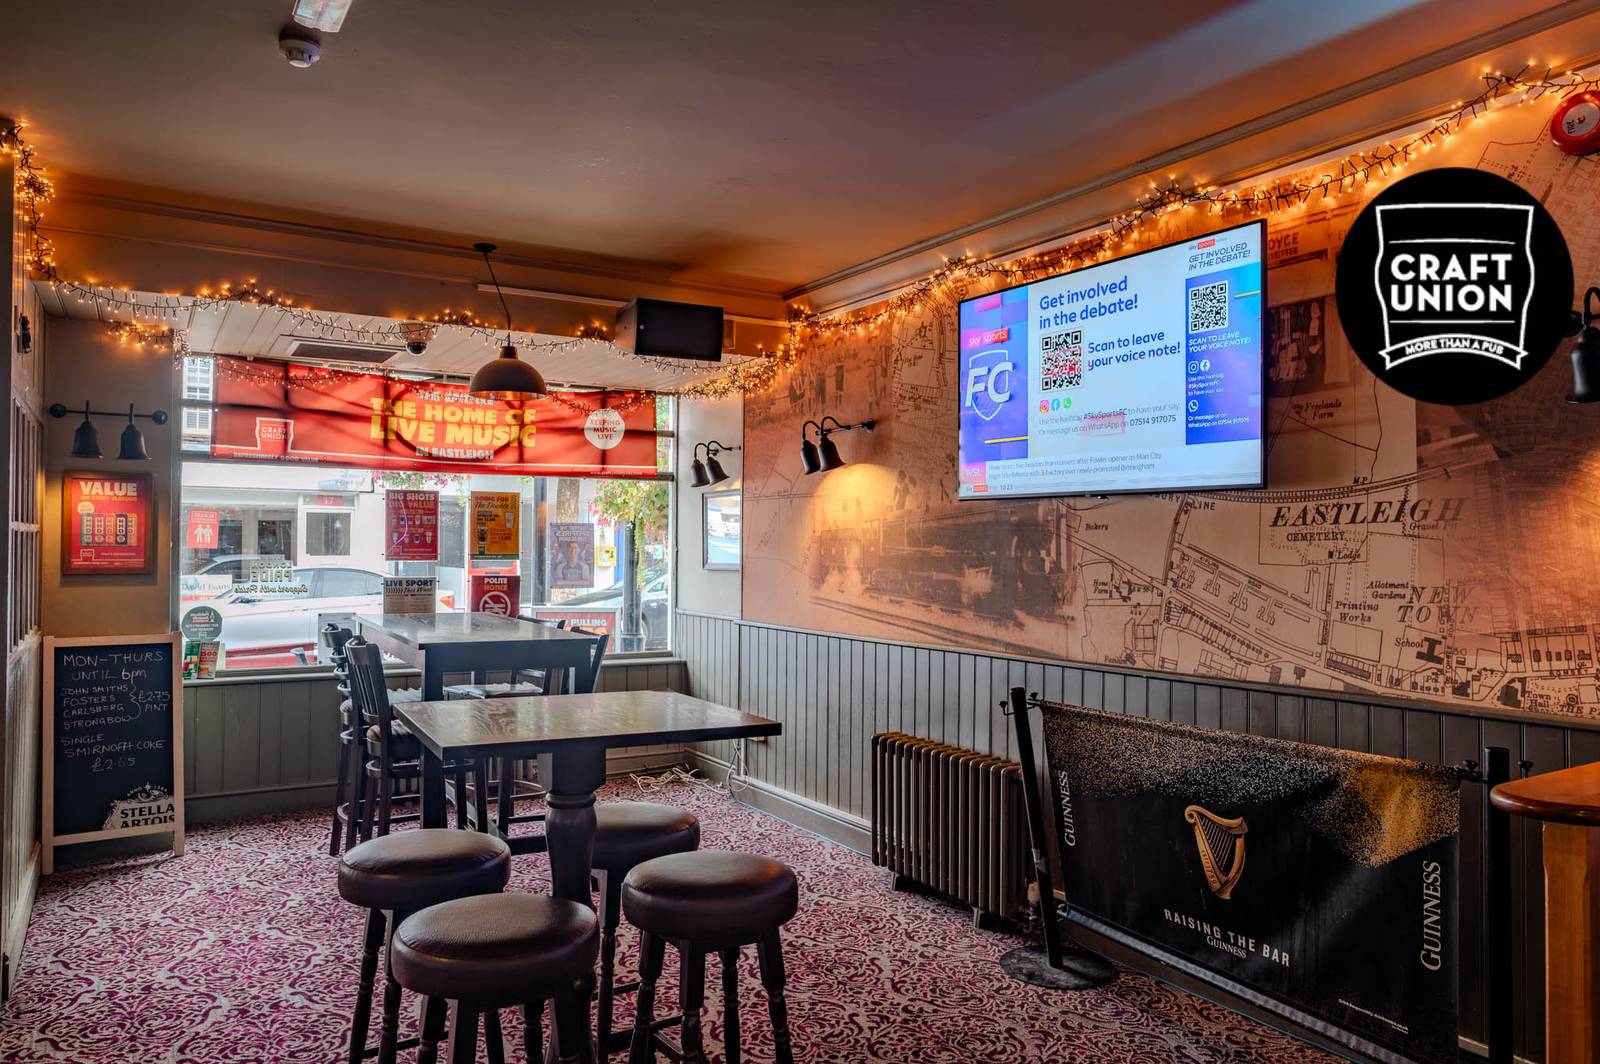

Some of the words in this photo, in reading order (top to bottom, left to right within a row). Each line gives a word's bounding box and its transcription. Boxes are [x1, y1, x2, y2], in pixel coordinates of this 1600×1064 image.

[1189, 252, 1205, 263] GET
[1206, 242, 1248, 258] INVOLVED
[1189, 263, 1198, 271] IN
[1198, 258, 1214, 268] THE
[1216, 249, 1251, 264] DEBATE!
[1040, 293, 1064, 311] Get
[1067, 275, 1128, 305] involved
[1040, 315, 1051, 329] in
[1054, 311, 1077, 326] the
[1080, 293, 1139, 320] debate!
[969, 336, 982, 347] sky
[983, 329, 1008, 343] sports
[1088, 341, 1115, 354] Scan
[1117, 338, 1130, 348] to
[1132, 332, 1165, 345] leave
[1189, 337, 1207, 346] SCAN
[1218, 331, 1240, 341] LEAVE
[1189, 344, 1207, 352] YOUR
[1208, 341, 1229, 350] VOICE
[1088, 356, 1113, 371] your
[1115, 350, 1146, 364] voice
[1148, 342, 1181, 359] note!
[965, 362, 1013, 408] FC
[370, 397, 417, 418] THE
[424, 404, 497, 425] HOME
[505, 408, 536, 424] OF
[1084, 407, 1128, 420] #SkySportsFC
[1130, 417, 1150, 426] 07514
[1151, 414, 1176, 425] 917075
[261, 426, 287, 434] CRAFT
[370, 415, 435, 442] LIVE
[445, 423, 537, 448] MUSIC
[416, 447, 429, 457] IN
[431, 448, 494, 460] EASTLEIGH
[80, 481, 138, 497] VALUE
[323, 496, 335, 505] 17
[389, 492, 404, 501] BIG
[406, 492, 436, 501] SHOTS
[1269, 497, 1466, 528] EASTLEIGH
[1286, 532, 1346, 542] CEMETERY
[1337, 551, 1361, 561] Lodge
[405, 579, 433, 587] SPORT
[1367, 580, 1409, 590] Allotment
[1371, 590, 1406, 600] Gardens
[1408, 585, 1476, 605] NEW
[1335, 600, 1379, 612] Printing
[1340, 612, 1372, 623] Works
[1397, 604, 1481, 624] TOWN
[571, 618, 607, 627] PULLING
[1395, 637, 1424, 649] School
[71, 670, 119, 681] UNTIL
[121, 668, 147, 684] 6pm
[61, 687, 89, 696] JOHN
[92, 684, 128, 694] SMITHS
[1526, 690, 1552, 700] Town
[63, 695, 116, 708] FOSTERS
[144, 703, 169, 713] PINT
[1529, 699, 1550, 709] Hall
[63, 703, 125, 718] CARLSBERG
[1560, 704, 1584, 714] THE
[63, 714, 132, 730] STRONGBOW
[61, 734, 105, 747] SINGLE
[136, 739, 166, 750] COKE
[121, 803, 175, 819] STELLA
[1058, 768, 1076, 847] GUINNESS
[120, 814, 175, 829] ARTOIS
[1420, 860, 1441, 971] GUINNESS
[1164, 908, 1221, 939] RAISING
[1227, 931, 1256, 952] THE
[1262, 943, 1290, 968] BAR
[1206, 935, 1247, 959] GUINNESS
